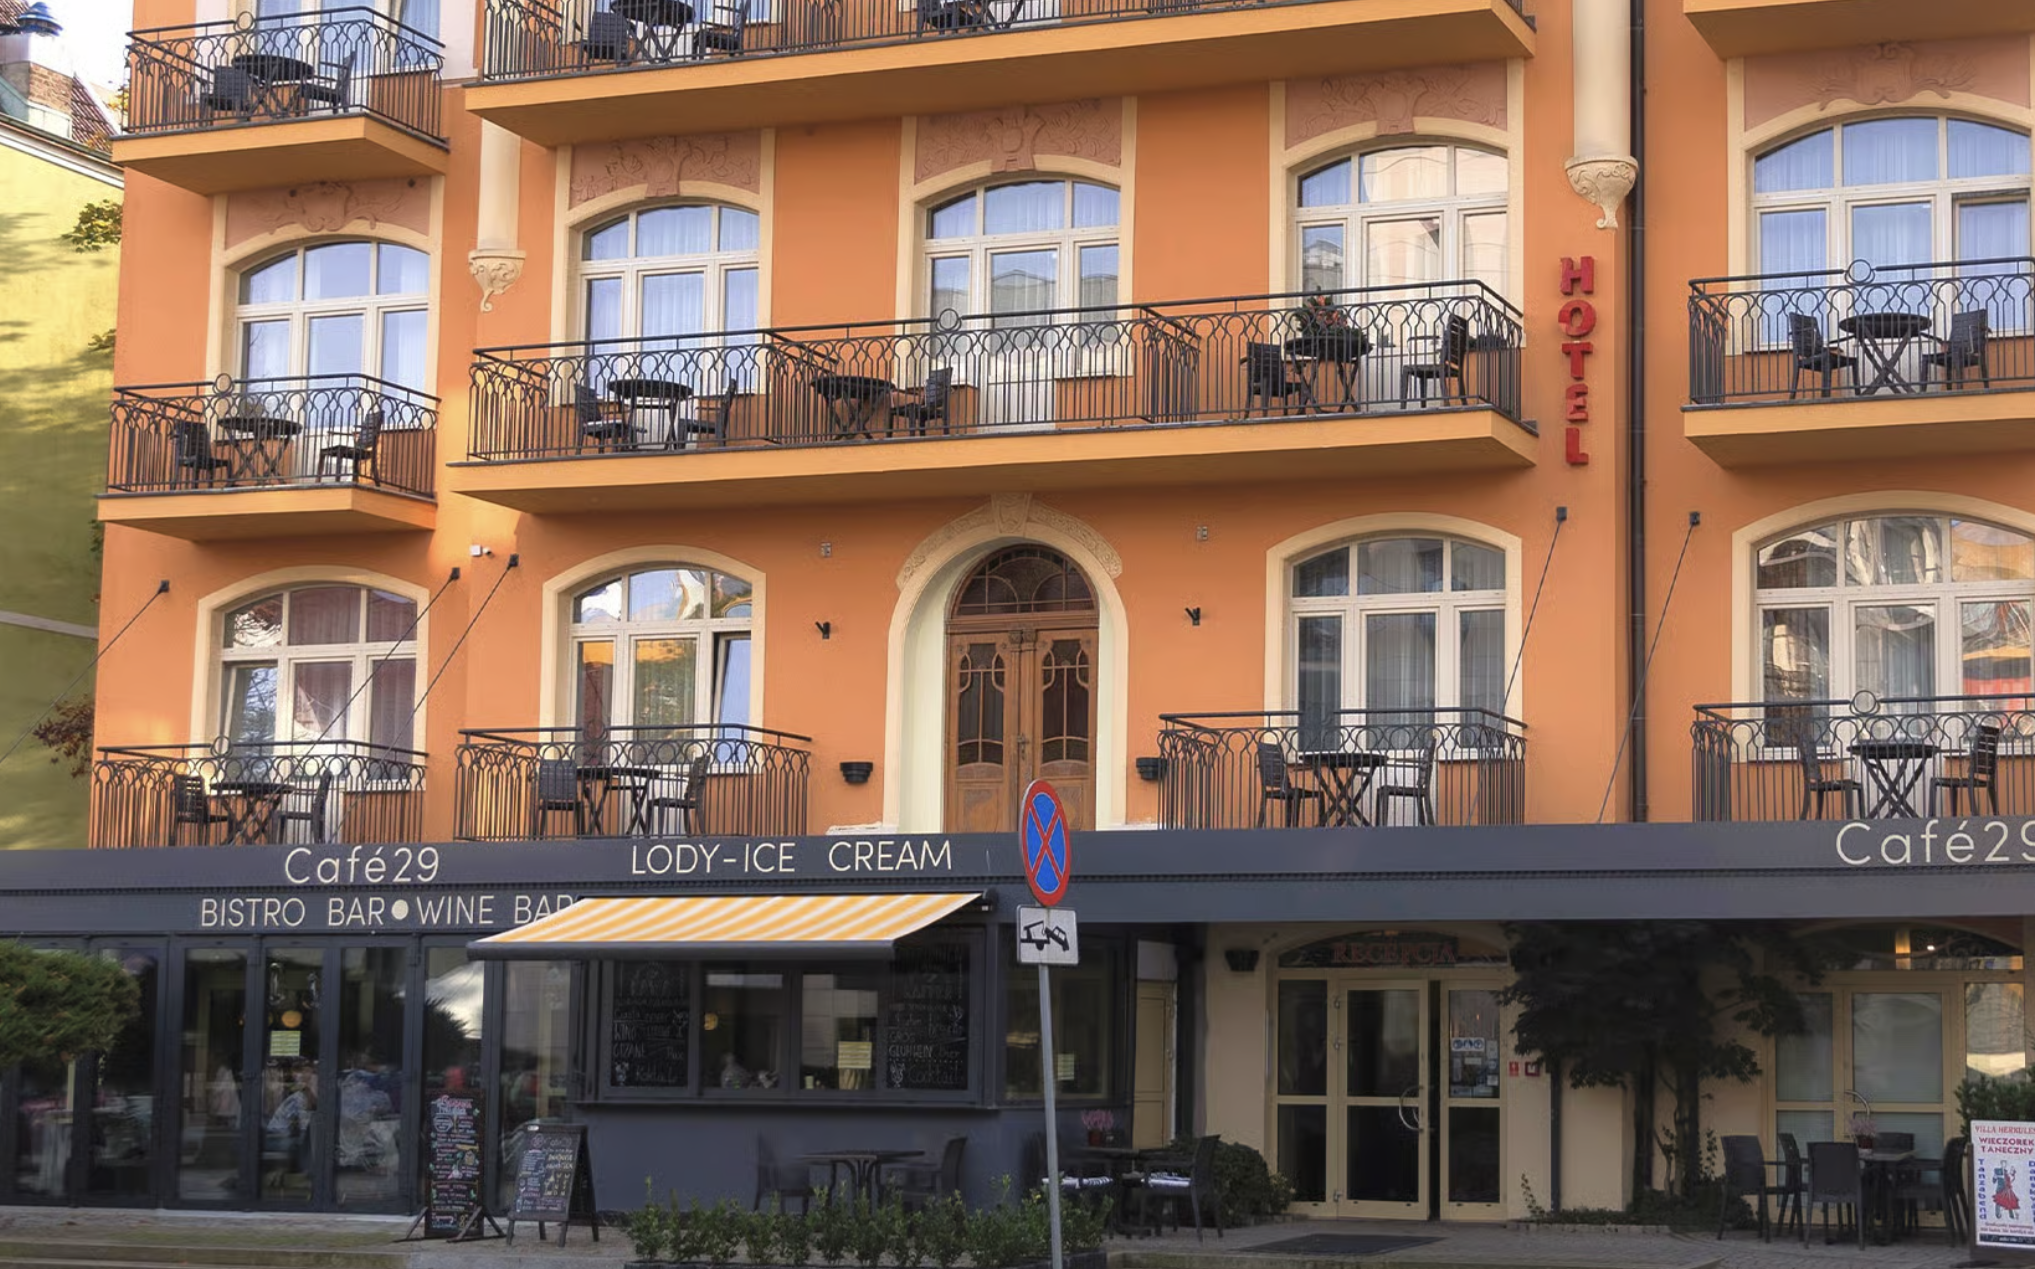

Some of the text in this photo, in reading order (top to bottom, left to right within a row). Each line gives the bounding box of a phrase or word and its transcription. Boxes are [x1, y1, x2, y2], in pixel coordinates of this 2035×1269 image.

[1558, 256, 1597, 465] HOTEL
[284, 845, 440, 884] Café29
[828, 840, 952, 872] CREAM
[201, 897, 306, 927] BISTRO
[328, 896, 385, 927] BAR
[416, 895, 494, 925] WINE
[1979, 1137, 2034, 1146] WIECZOREK
[1981, 1145, 2034, 1155] TANECZNY
